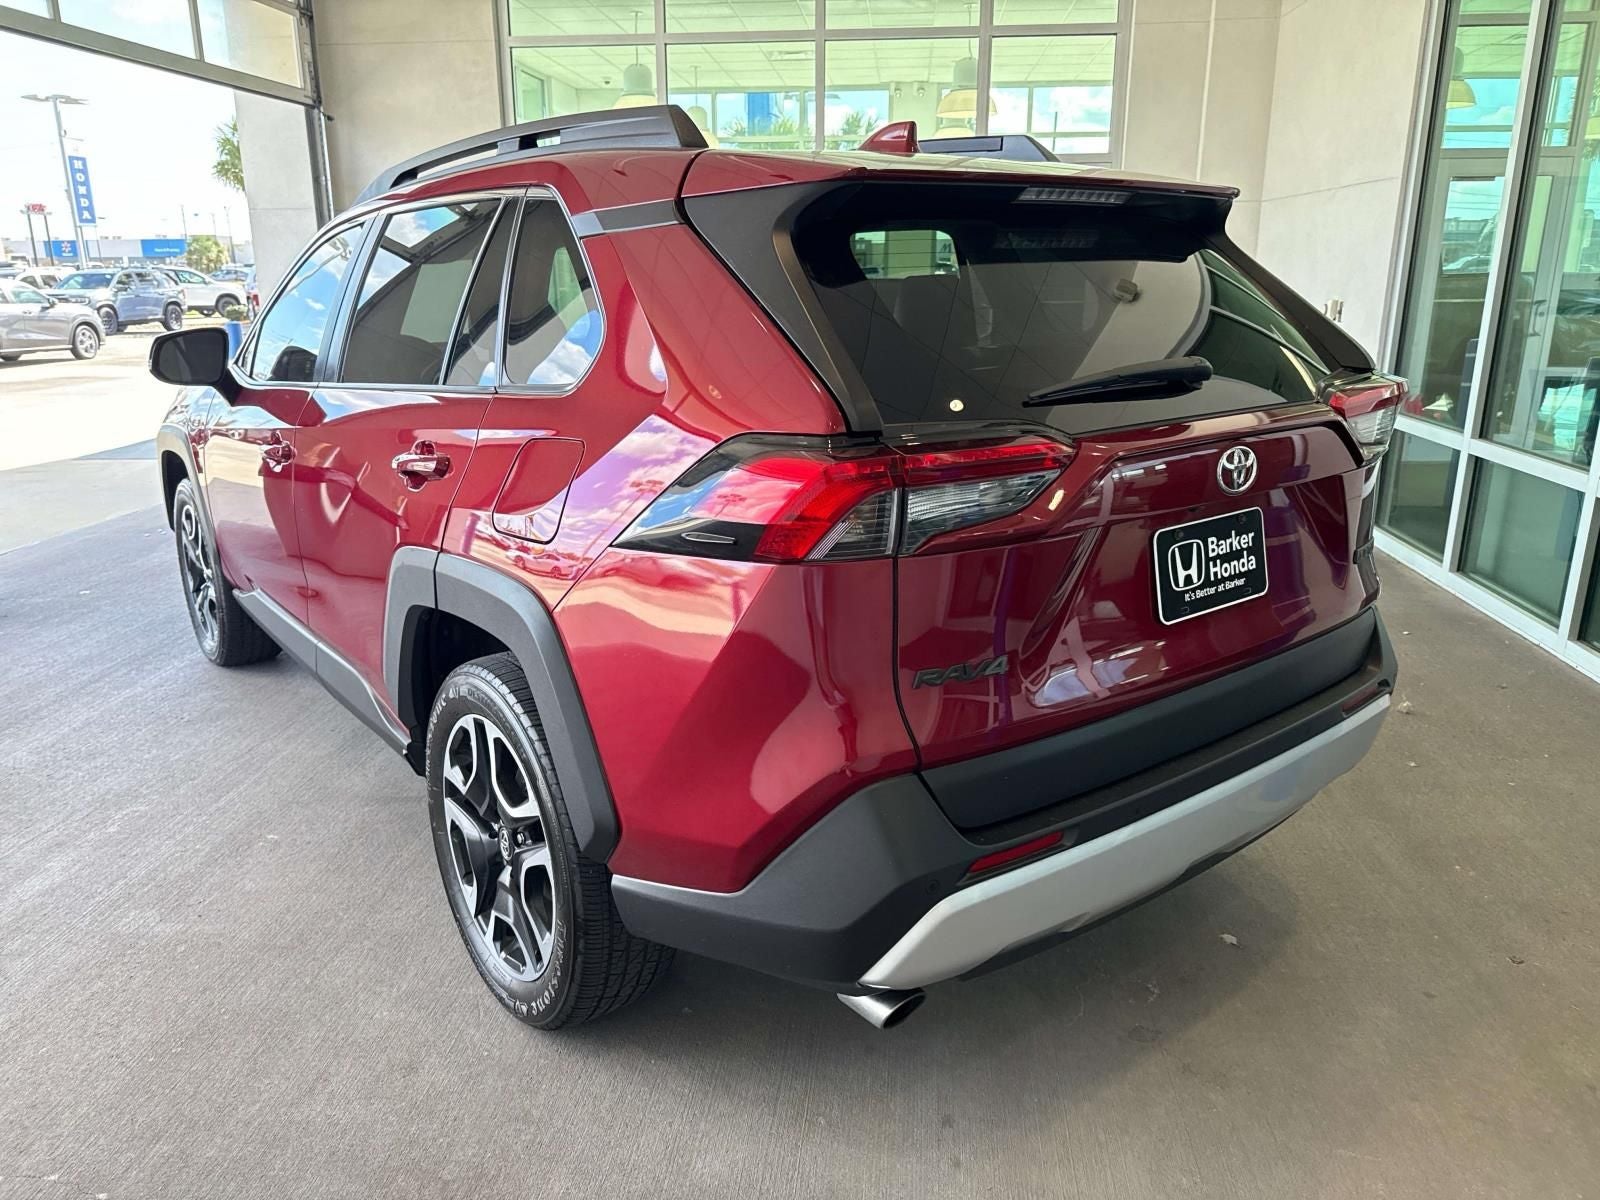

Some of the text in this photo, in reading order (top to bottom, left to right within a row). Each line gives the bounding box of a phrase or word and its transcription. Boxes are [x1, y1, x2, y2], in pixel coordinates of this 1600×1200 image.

[73, 159, 92, 220] HONDA
[1207, 530, 1255, 558] Barker
[1209, 551, 1257, 582] Honda
[1184, 577, 1246, 602] It's Better at Barker
[912, 654, 1008, 689] RAV4
